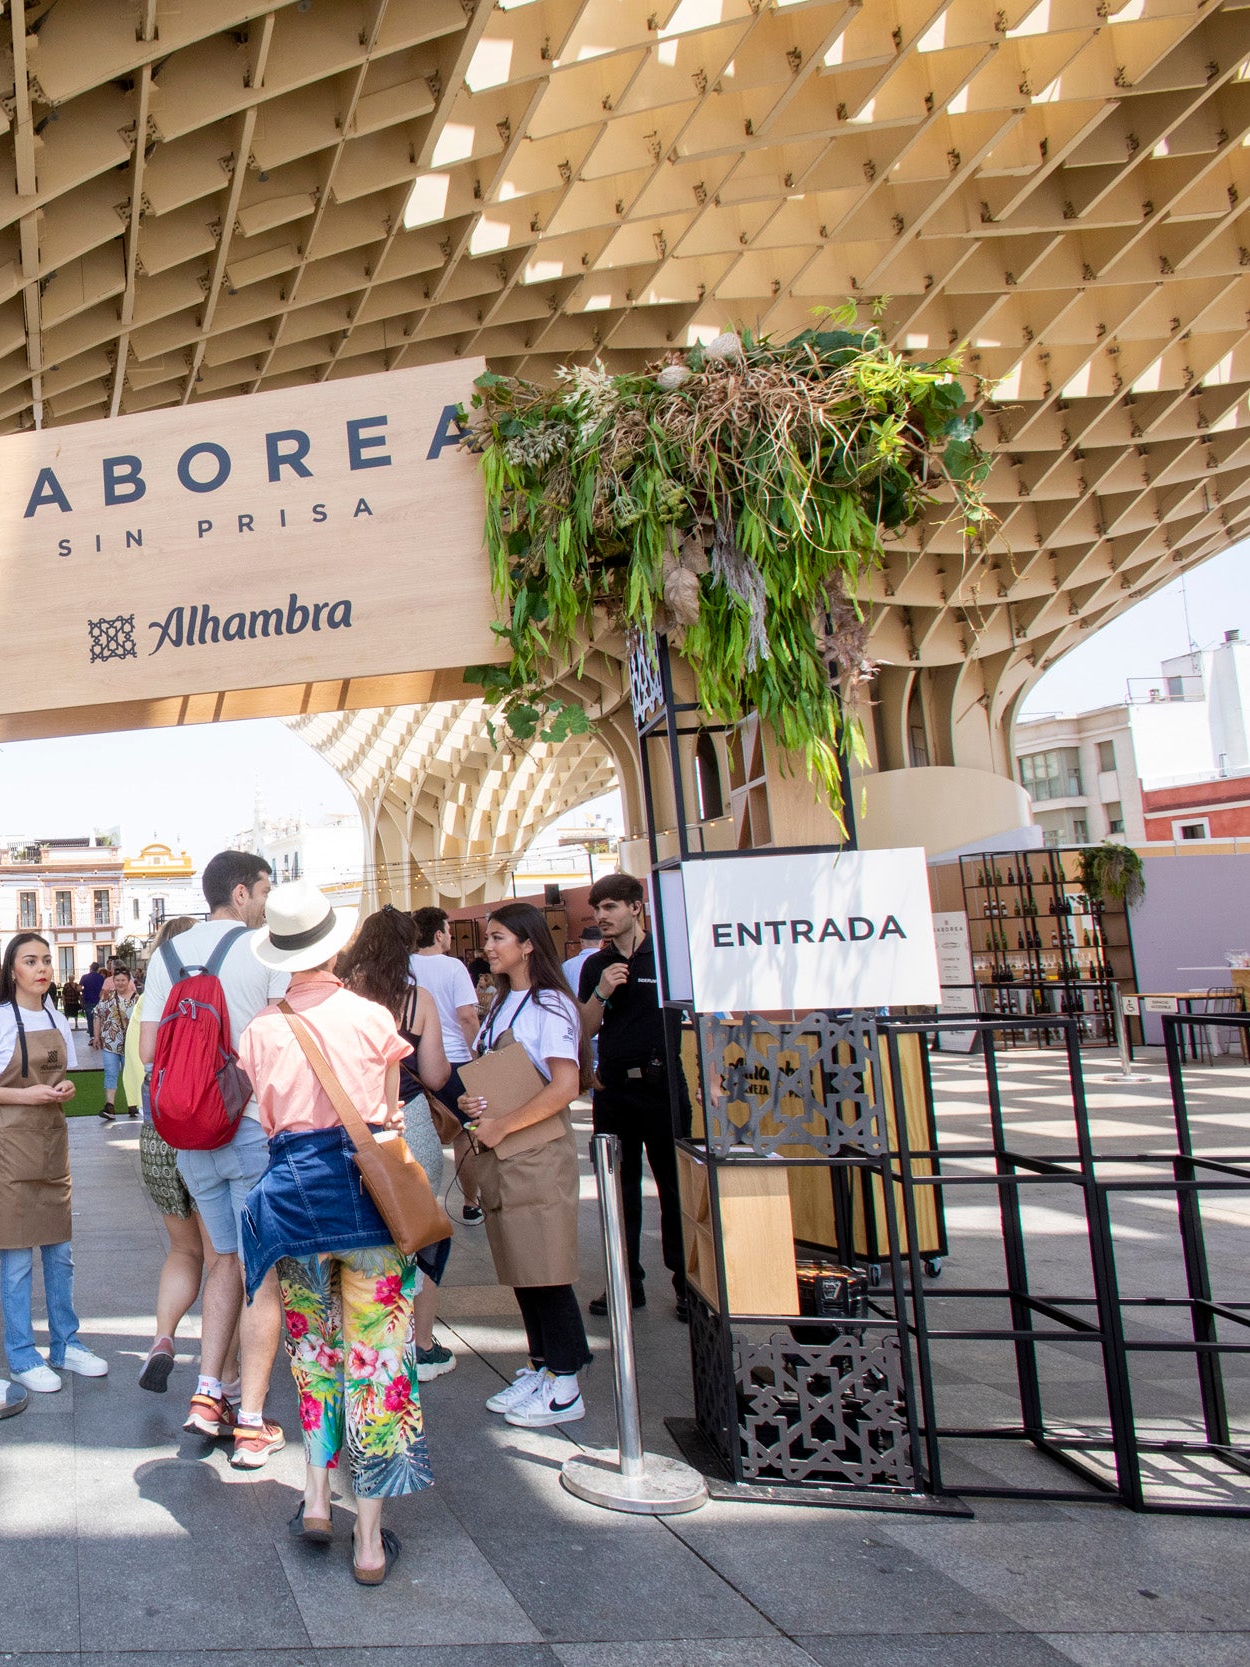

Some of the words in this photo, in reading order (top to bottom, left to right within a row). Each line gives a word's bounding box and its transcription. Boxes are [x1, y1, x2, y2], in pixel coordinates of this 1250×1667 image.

[57, 528, 144, 558] SIN
[197, 497, 374, 539] PRISA
[148, 593, 353, 656] Alhambra
[712, 914, 907, 948] ENTRADA
